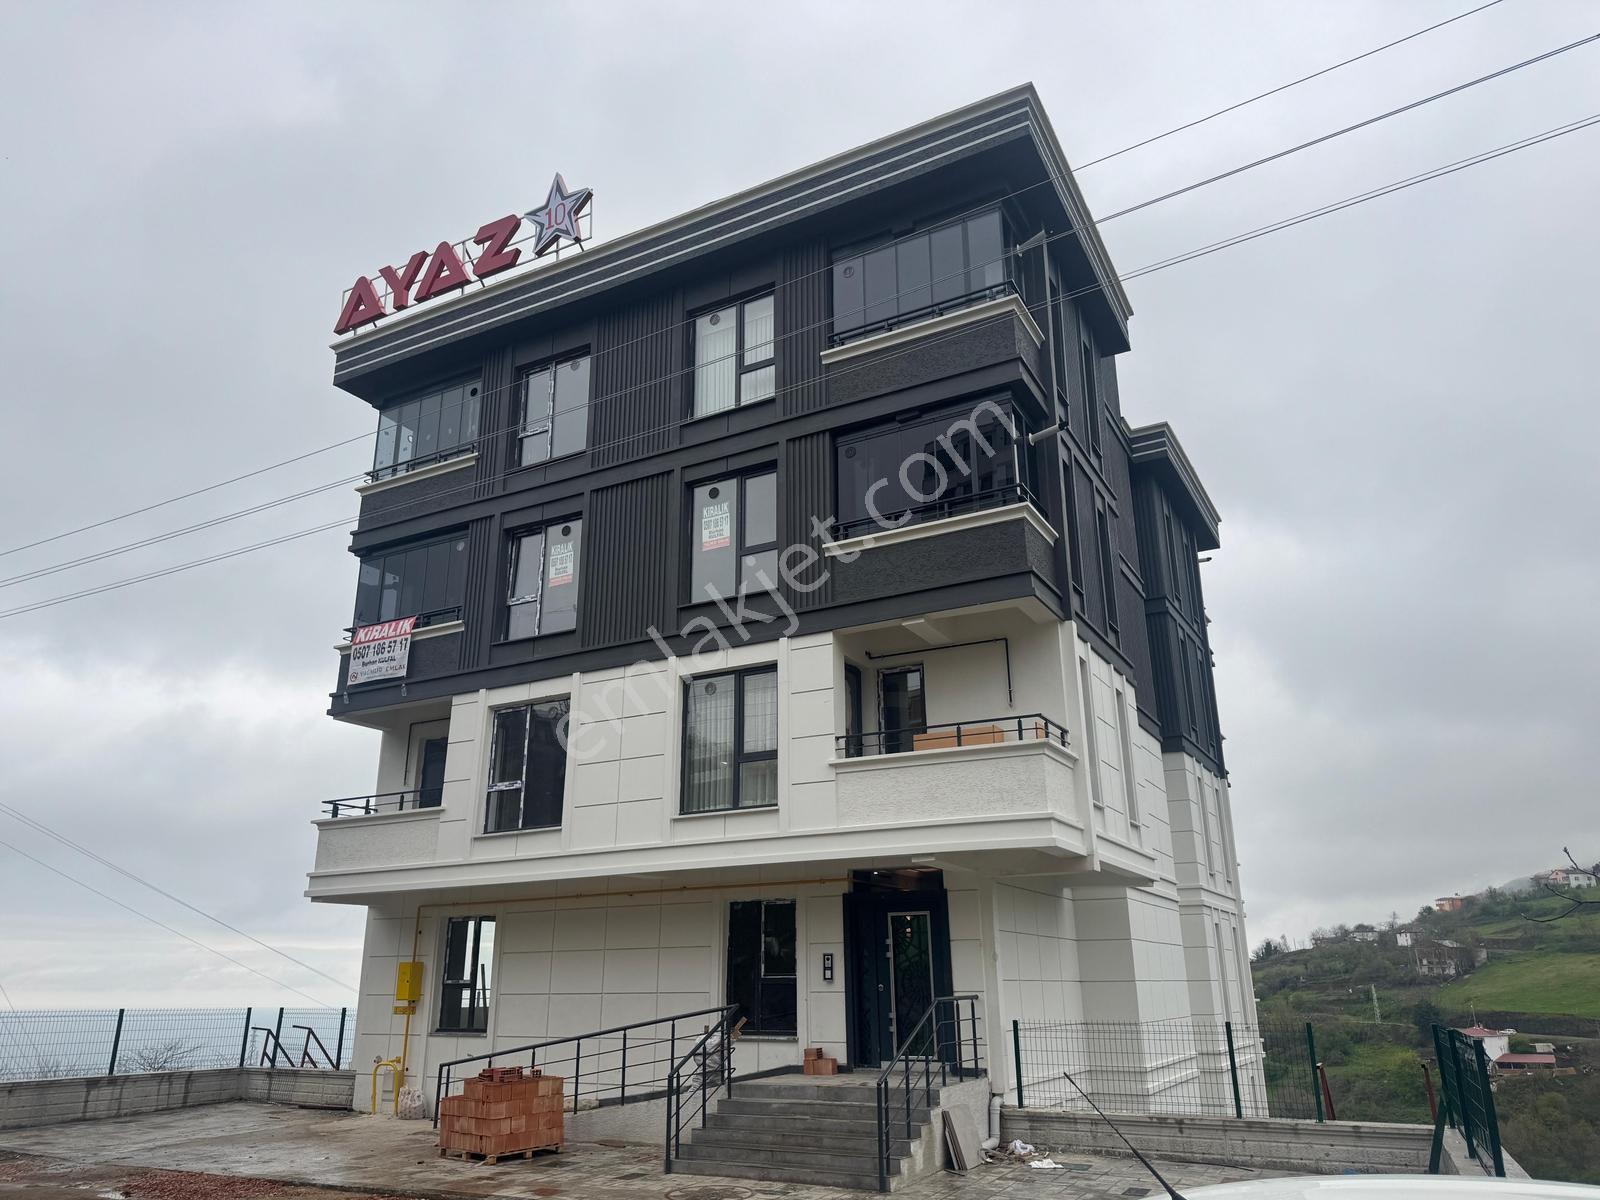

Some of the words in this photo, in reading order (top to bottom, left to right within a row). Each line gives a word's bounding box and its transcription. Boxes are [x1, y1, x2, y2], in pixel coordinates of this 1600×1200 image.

[334, 214, 522, 336] AYAZ
[545, 202, 567, 230] 10
[353, 645, 370, 660] 0507
[372, 642, 385, 656] 186
[387, 640, 396, 654] 57
[399, 637, 408, 651] 17
